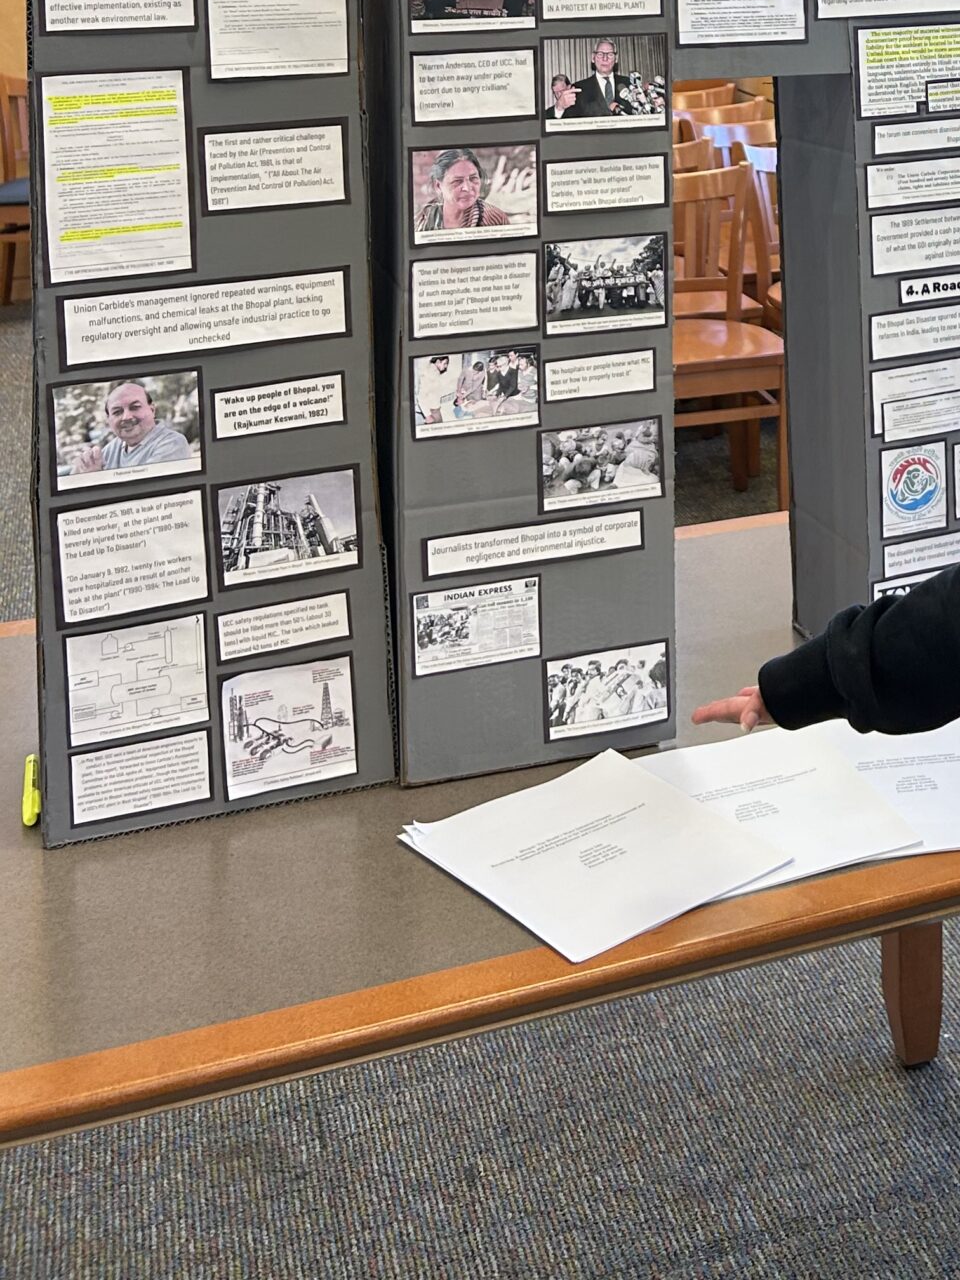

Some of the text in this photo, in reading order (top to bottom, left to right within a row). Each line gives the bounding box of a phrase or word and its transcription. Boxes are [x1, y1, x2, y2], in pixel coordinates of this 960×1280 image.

[906, 285, 918, 296] 4.
[922, 284, 930, 295] A
[258, 390, 282, 400] people
[294, 384, 319, 394] Bhopal,
[322, 383, 334, 391] you
[264, 403, 281, 412] edge
[234, 408, 328, 430] (Rajkumar Keswani, 1982)
[444, 585, 512, 601] INDIAN EXPRESS
